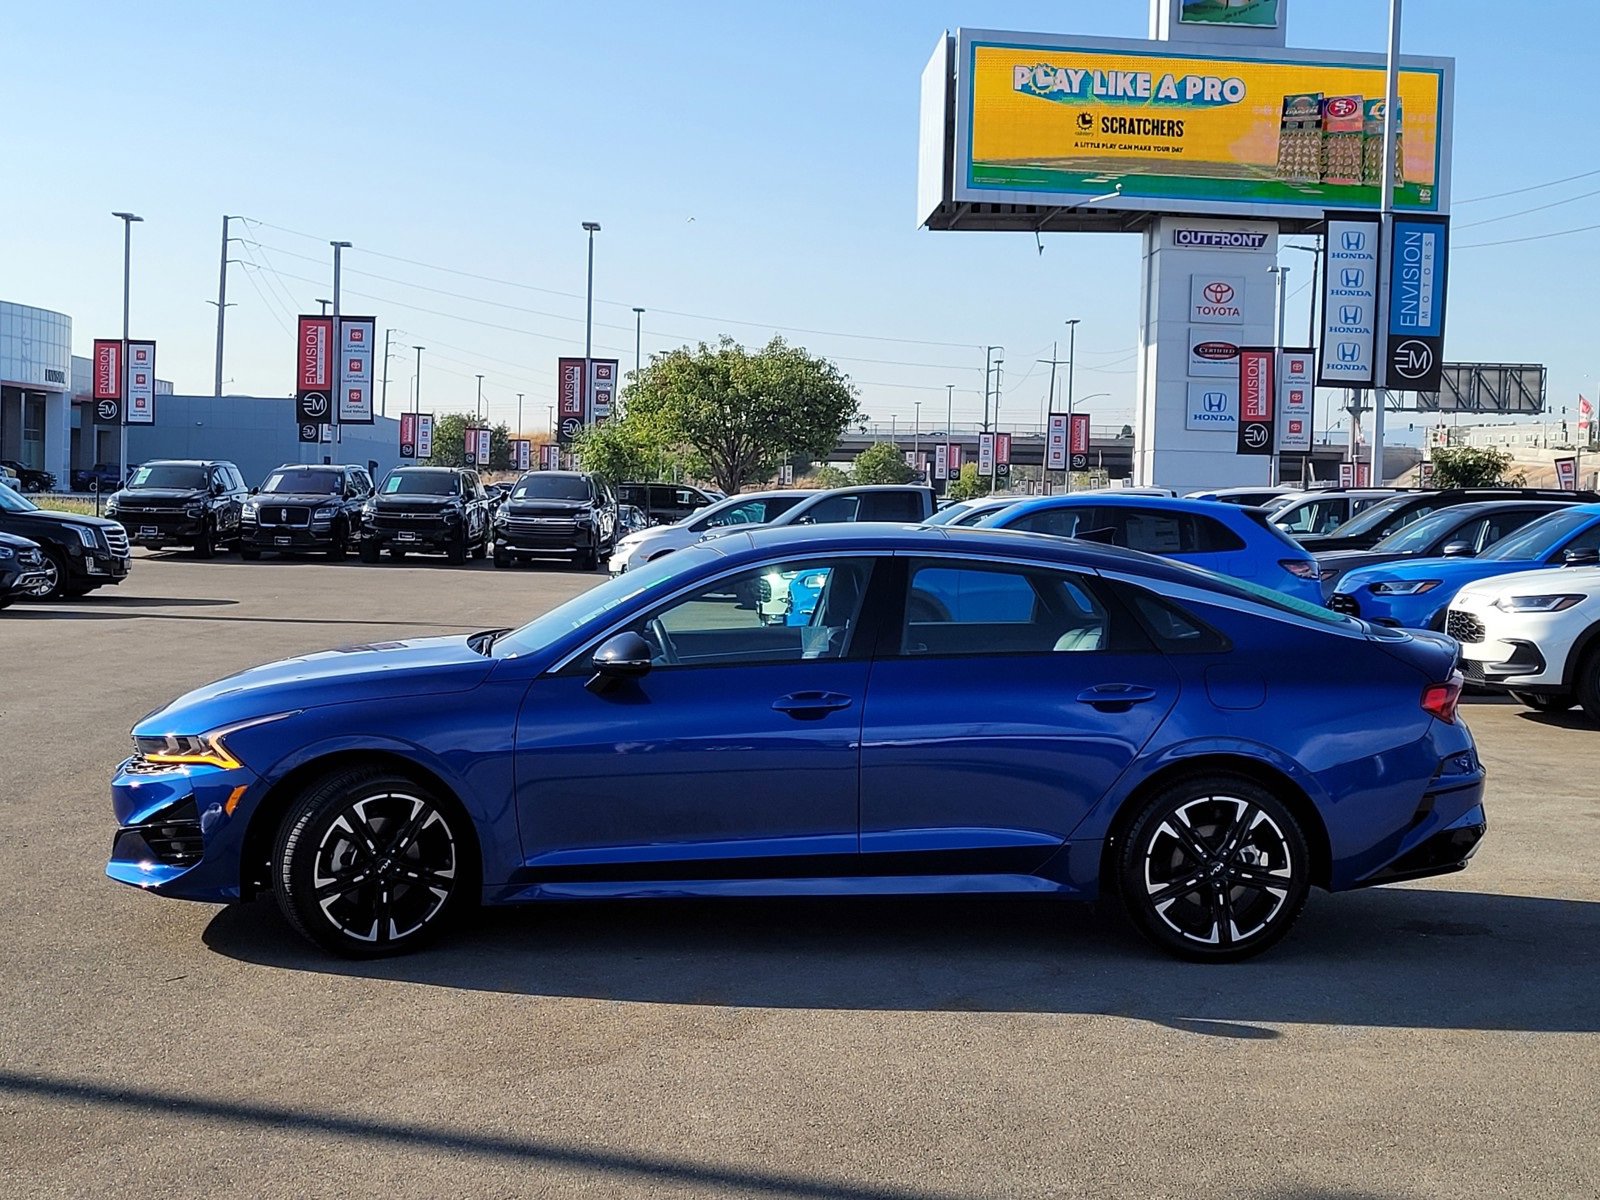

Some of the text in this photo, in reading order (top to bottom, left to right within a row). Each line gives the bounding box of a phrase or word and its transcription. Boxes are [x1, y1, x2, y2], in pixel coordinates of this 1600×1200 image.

[1013, 64, 1246, 102] PLAY LIKE A PRO
[1101, 116, 1184, 137] SCRATCHERS
[1179, 231, 1263, 247] OUTFRONT
[1331, 252, 1374, 260] HONDA
[1330, 289, 1372, 297] HONDA
[1400, 231, 1421, 327] ENVISION
[1422, 240, 1432, 319] MOTORS
[1196, 306, 1240, 317] TOYOTA
[1328, 326, 1370, 334] HONDA
[305, 325, 317, 385] ENVISION
[1326, 363, 1368, 371] HONDA
[99, 347, 109, 394] ENVISION
[564, 366, 574, 413] ENVISION
[1247, 357, 1259, 416] ENVISION
